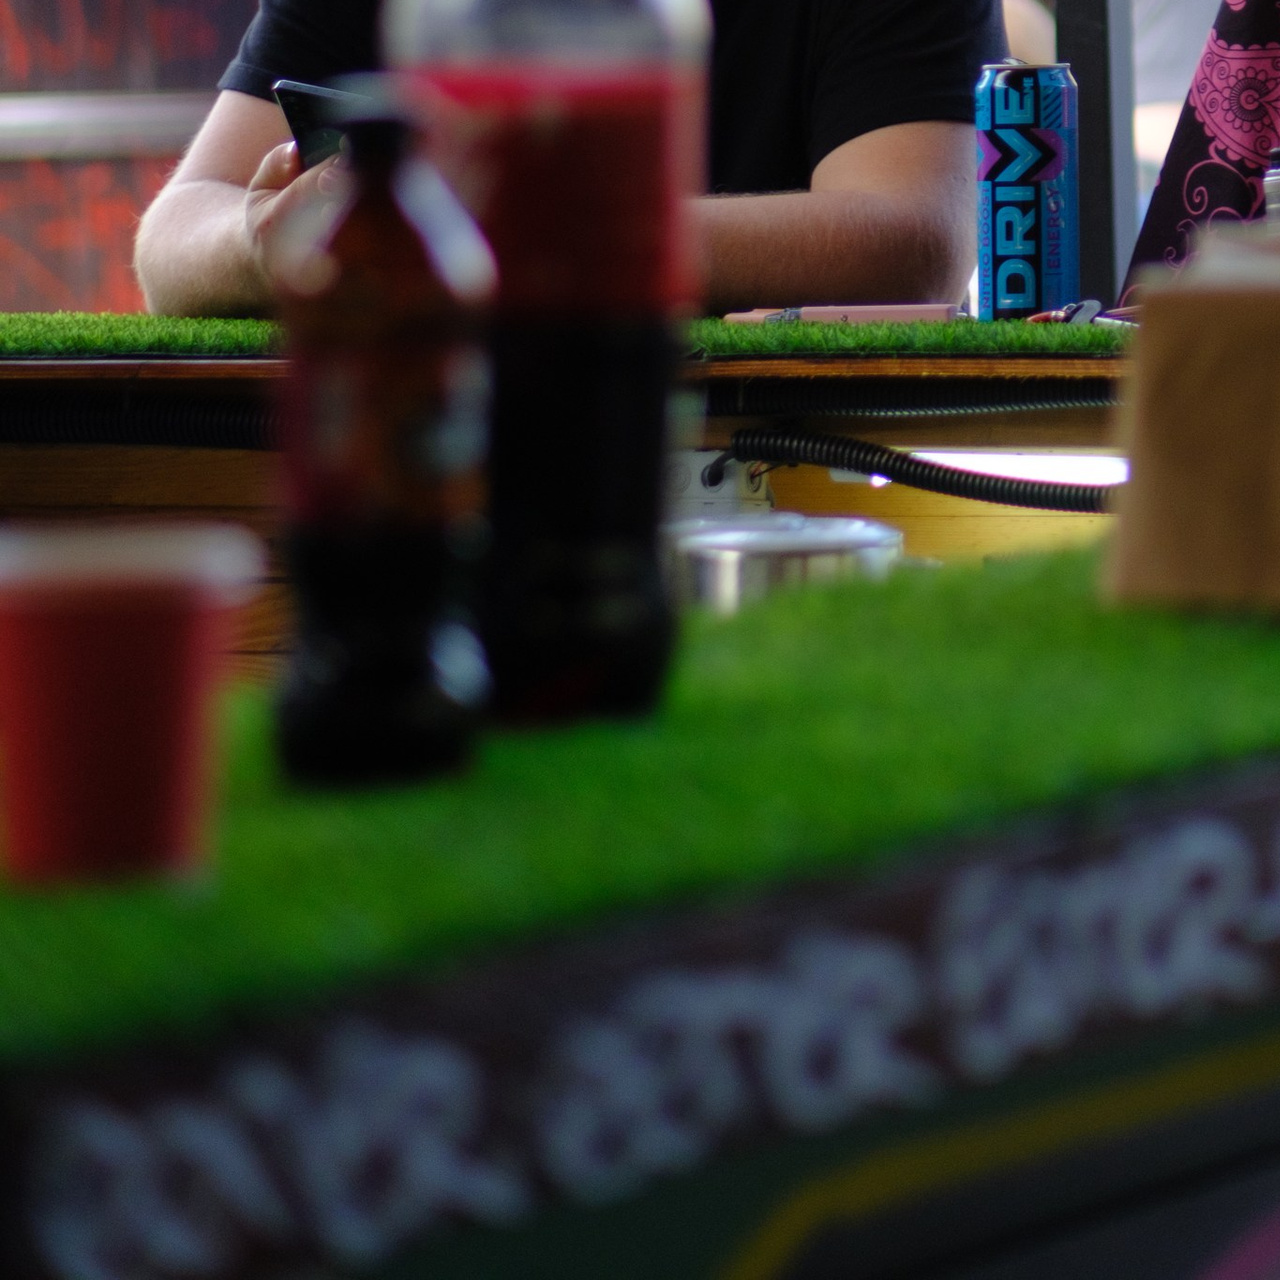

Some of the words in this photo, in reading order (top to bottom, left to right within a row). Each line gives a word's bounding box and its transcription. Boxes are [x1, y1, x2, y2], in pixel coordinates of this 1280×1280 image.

[994, 72, 1043, 309] DRIVE
[1046, 186, 1061, 269] ENERGY
[982, 252, 990, 308] NITRO
